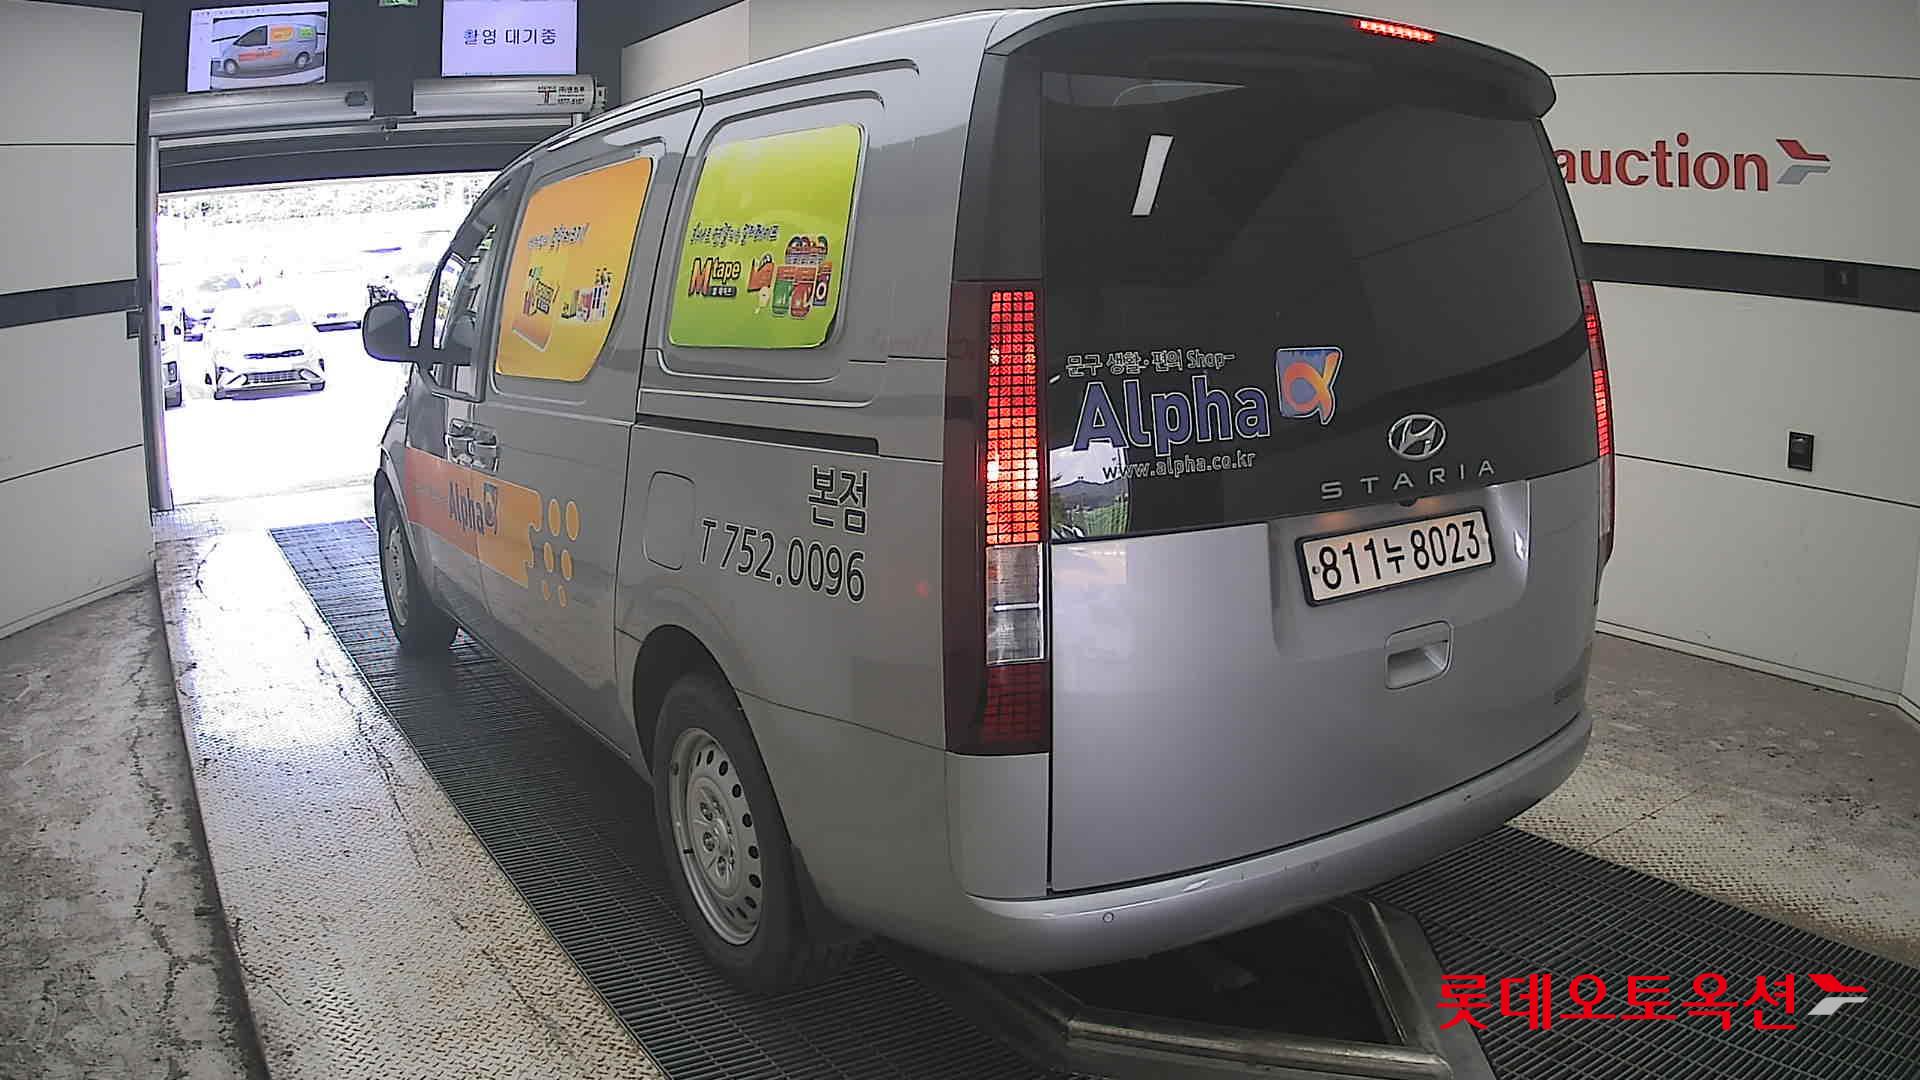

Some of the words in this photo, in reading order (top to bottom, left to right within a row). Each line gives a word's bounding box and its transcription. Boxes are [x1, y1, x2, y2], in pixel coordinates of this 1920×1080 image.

[505, 28, 556, 46] 대기중
[1553, 132, 1768, 191] auction
[1066, 353, 1103, 377] 문구
[1072, 375, 1271, 457] Alpha
[1102, 450, 1256, 479] www.alpha.co.kr
[1320, 460, 1495, 500] STARIA
[808, 464, 868, 535] 본점
[719, 520, 866, 603] 752.0096
